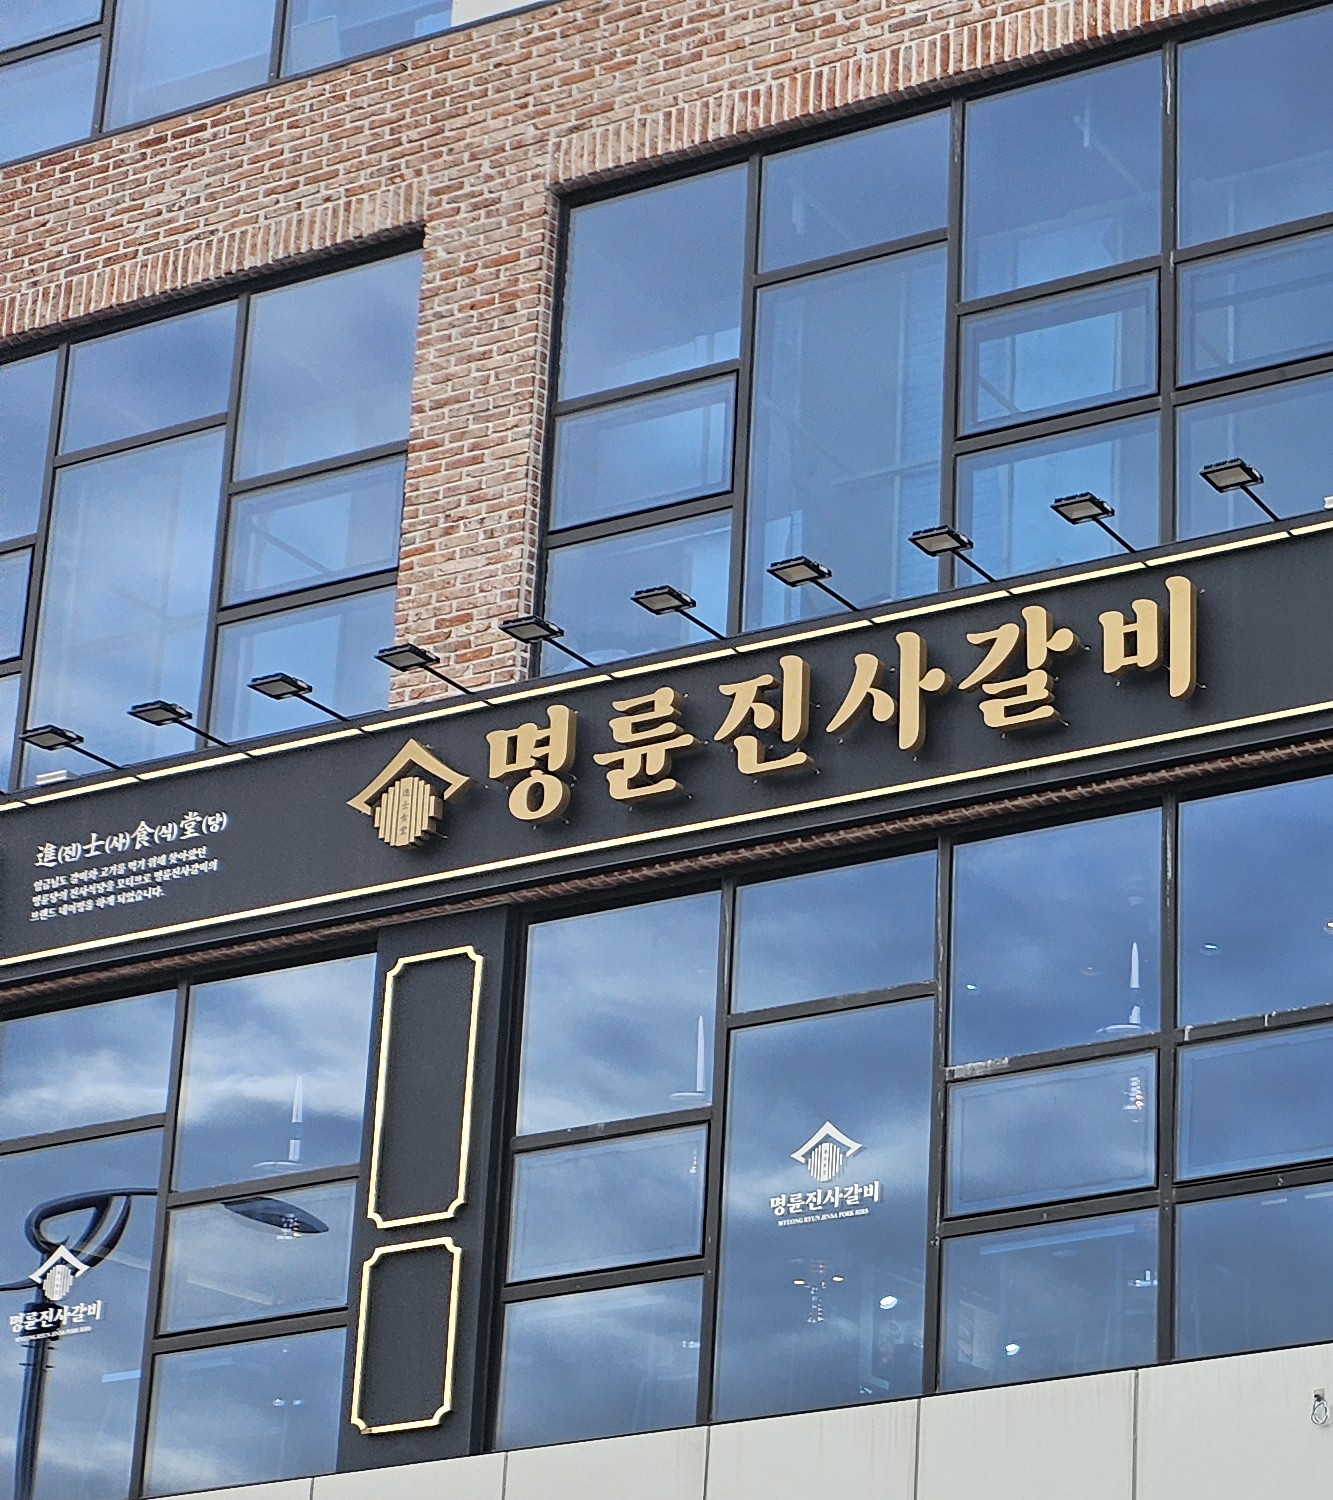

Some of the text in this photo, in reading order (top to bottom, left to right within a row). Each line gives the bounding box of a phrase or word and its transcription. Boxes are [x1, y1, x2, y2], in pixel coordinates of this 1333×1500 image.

[486, 576, 1198, 822] 명륜진사갈비
[769, 1180, 880, 1216] 명륜진사갈비
[9, 1300, 102, 1333] 명륜진사갈비
